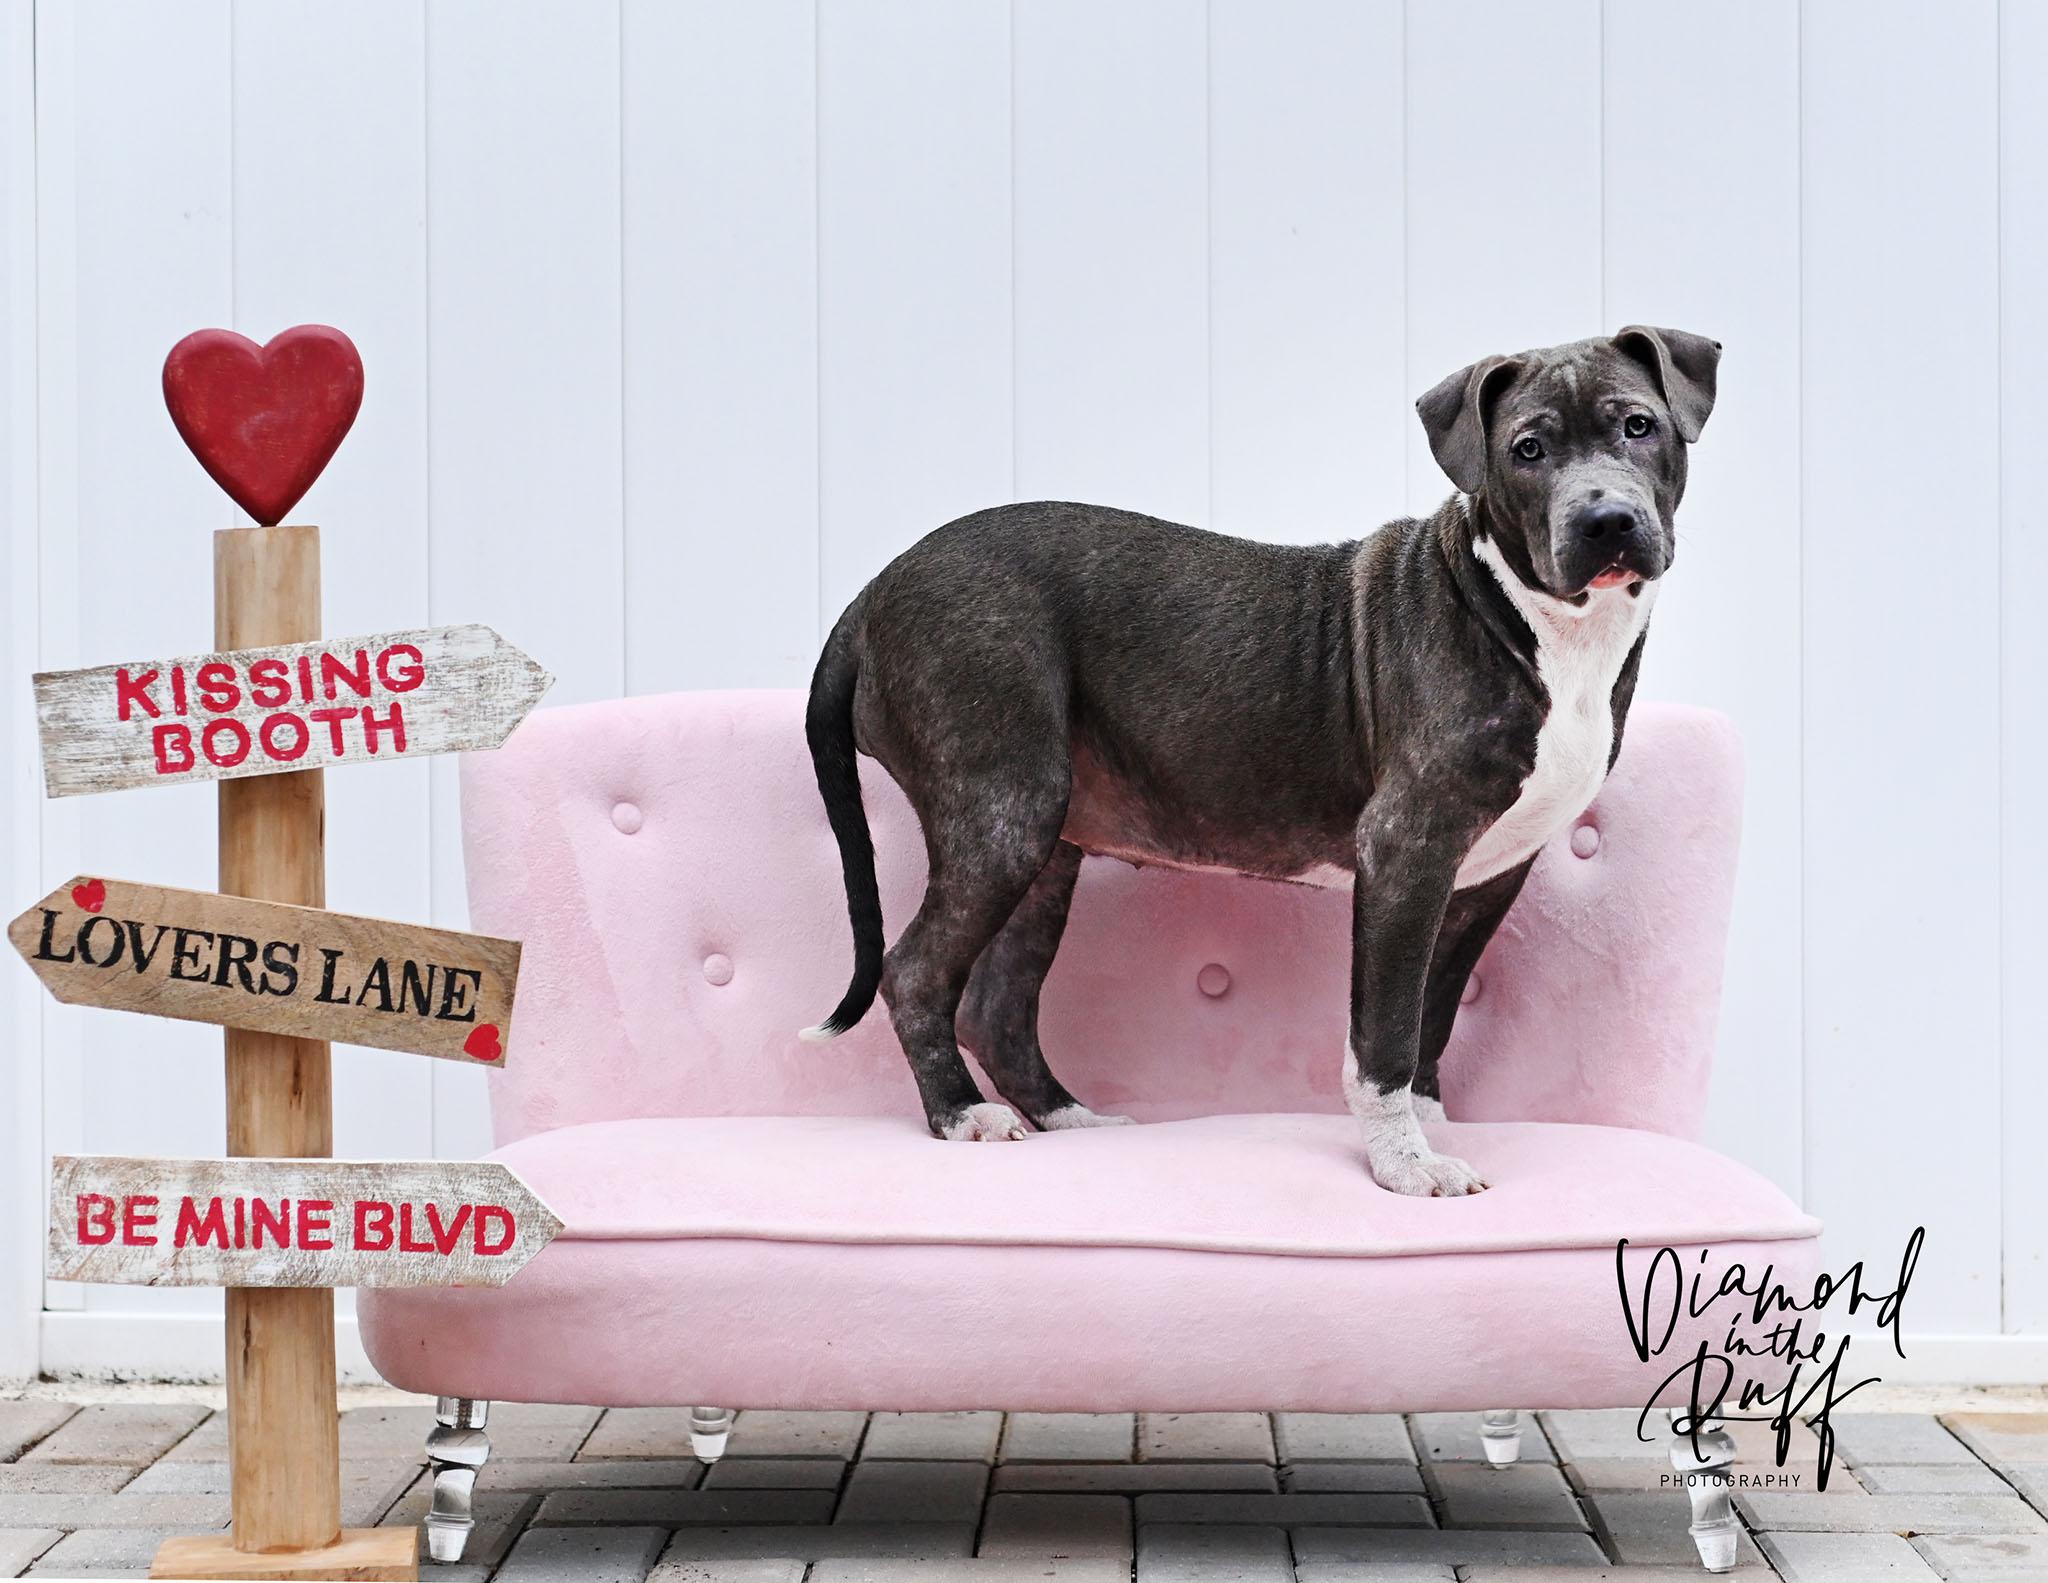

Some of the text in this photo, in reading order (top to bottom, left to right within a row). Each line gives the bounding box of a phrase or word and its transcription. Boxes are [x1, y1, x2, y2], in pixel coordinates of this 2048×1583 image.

[116, 643, 425, 721] KISSING
[152, 701, 407, 775] BOOTH
[31, 908, 482, 1023] LOVERS LANE
[76, 1193, 517, 1256] BE MINE BLVD
